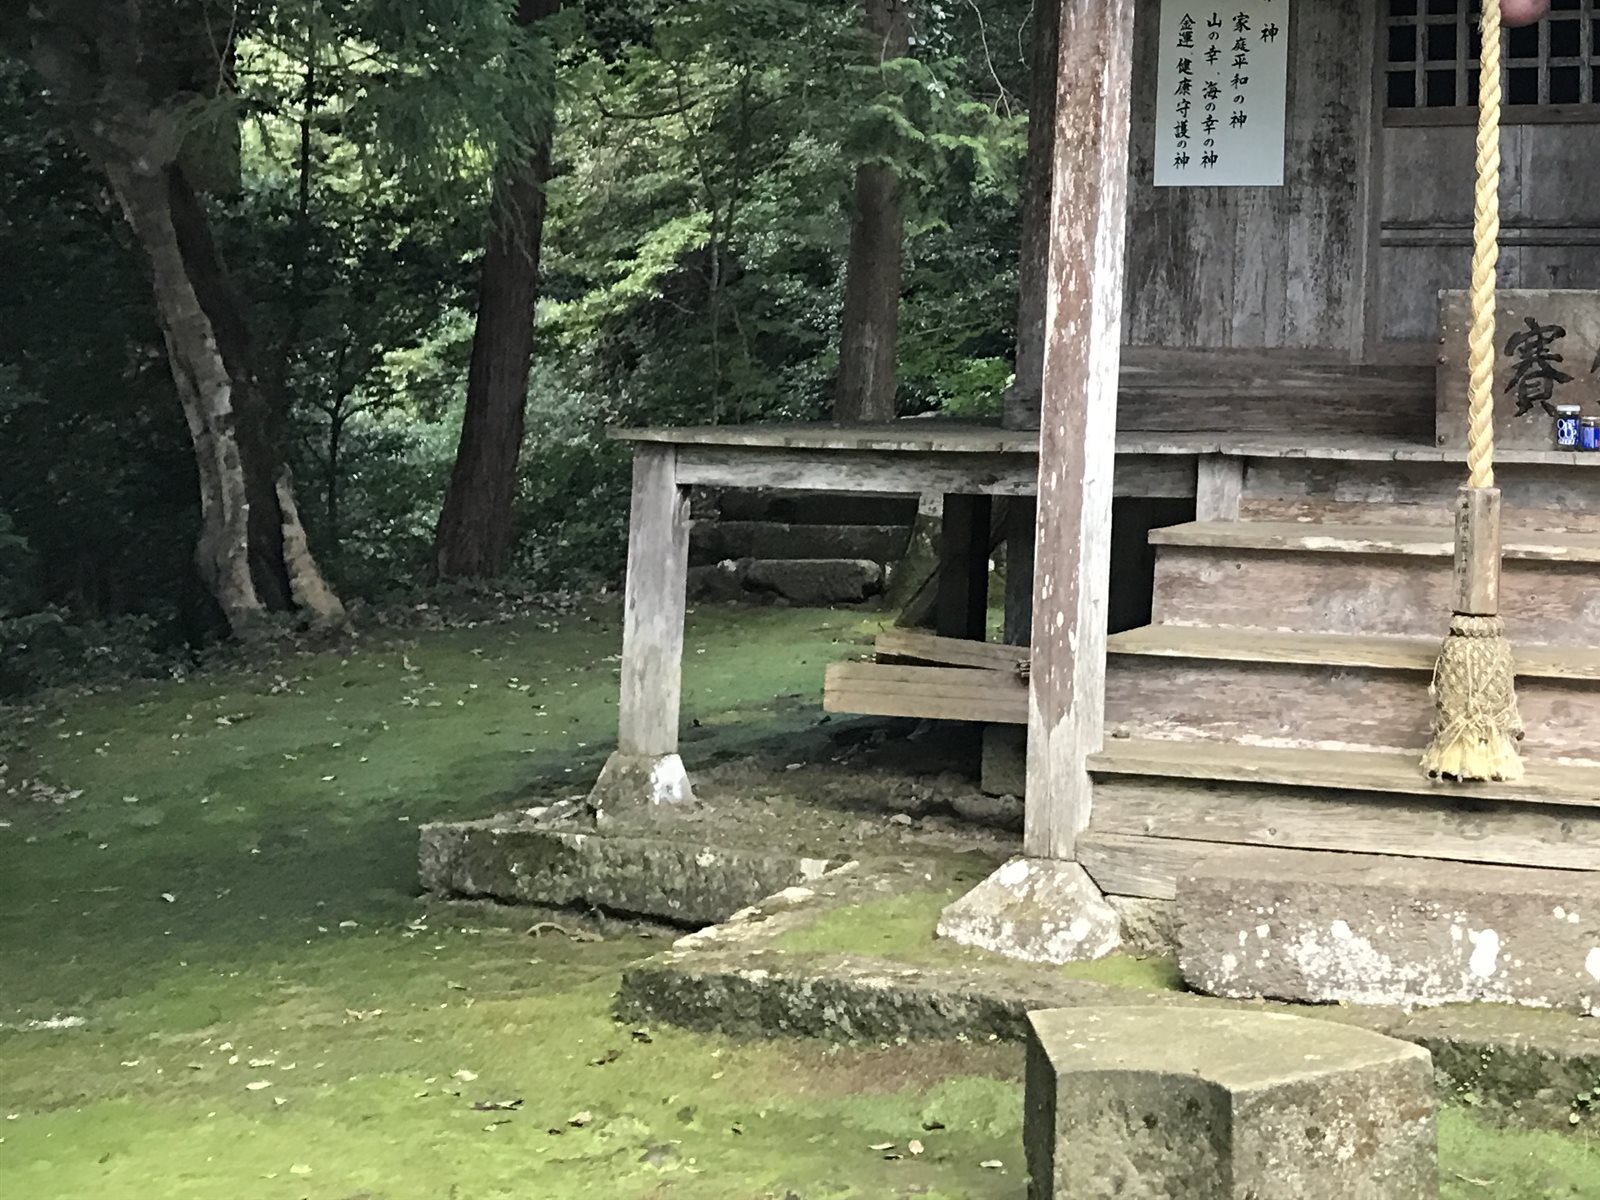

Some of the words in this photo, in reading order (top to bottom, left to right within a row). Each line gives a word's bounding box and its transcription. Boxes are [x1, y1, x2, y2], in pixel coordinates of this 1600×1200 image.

[1172, 13, 1196, 169] 金運、健康守護の神
[1200, 12, 1222, 169] 山の幸、海の幸の神
[1229, 12, 1252, 129] 家庭平和の神
